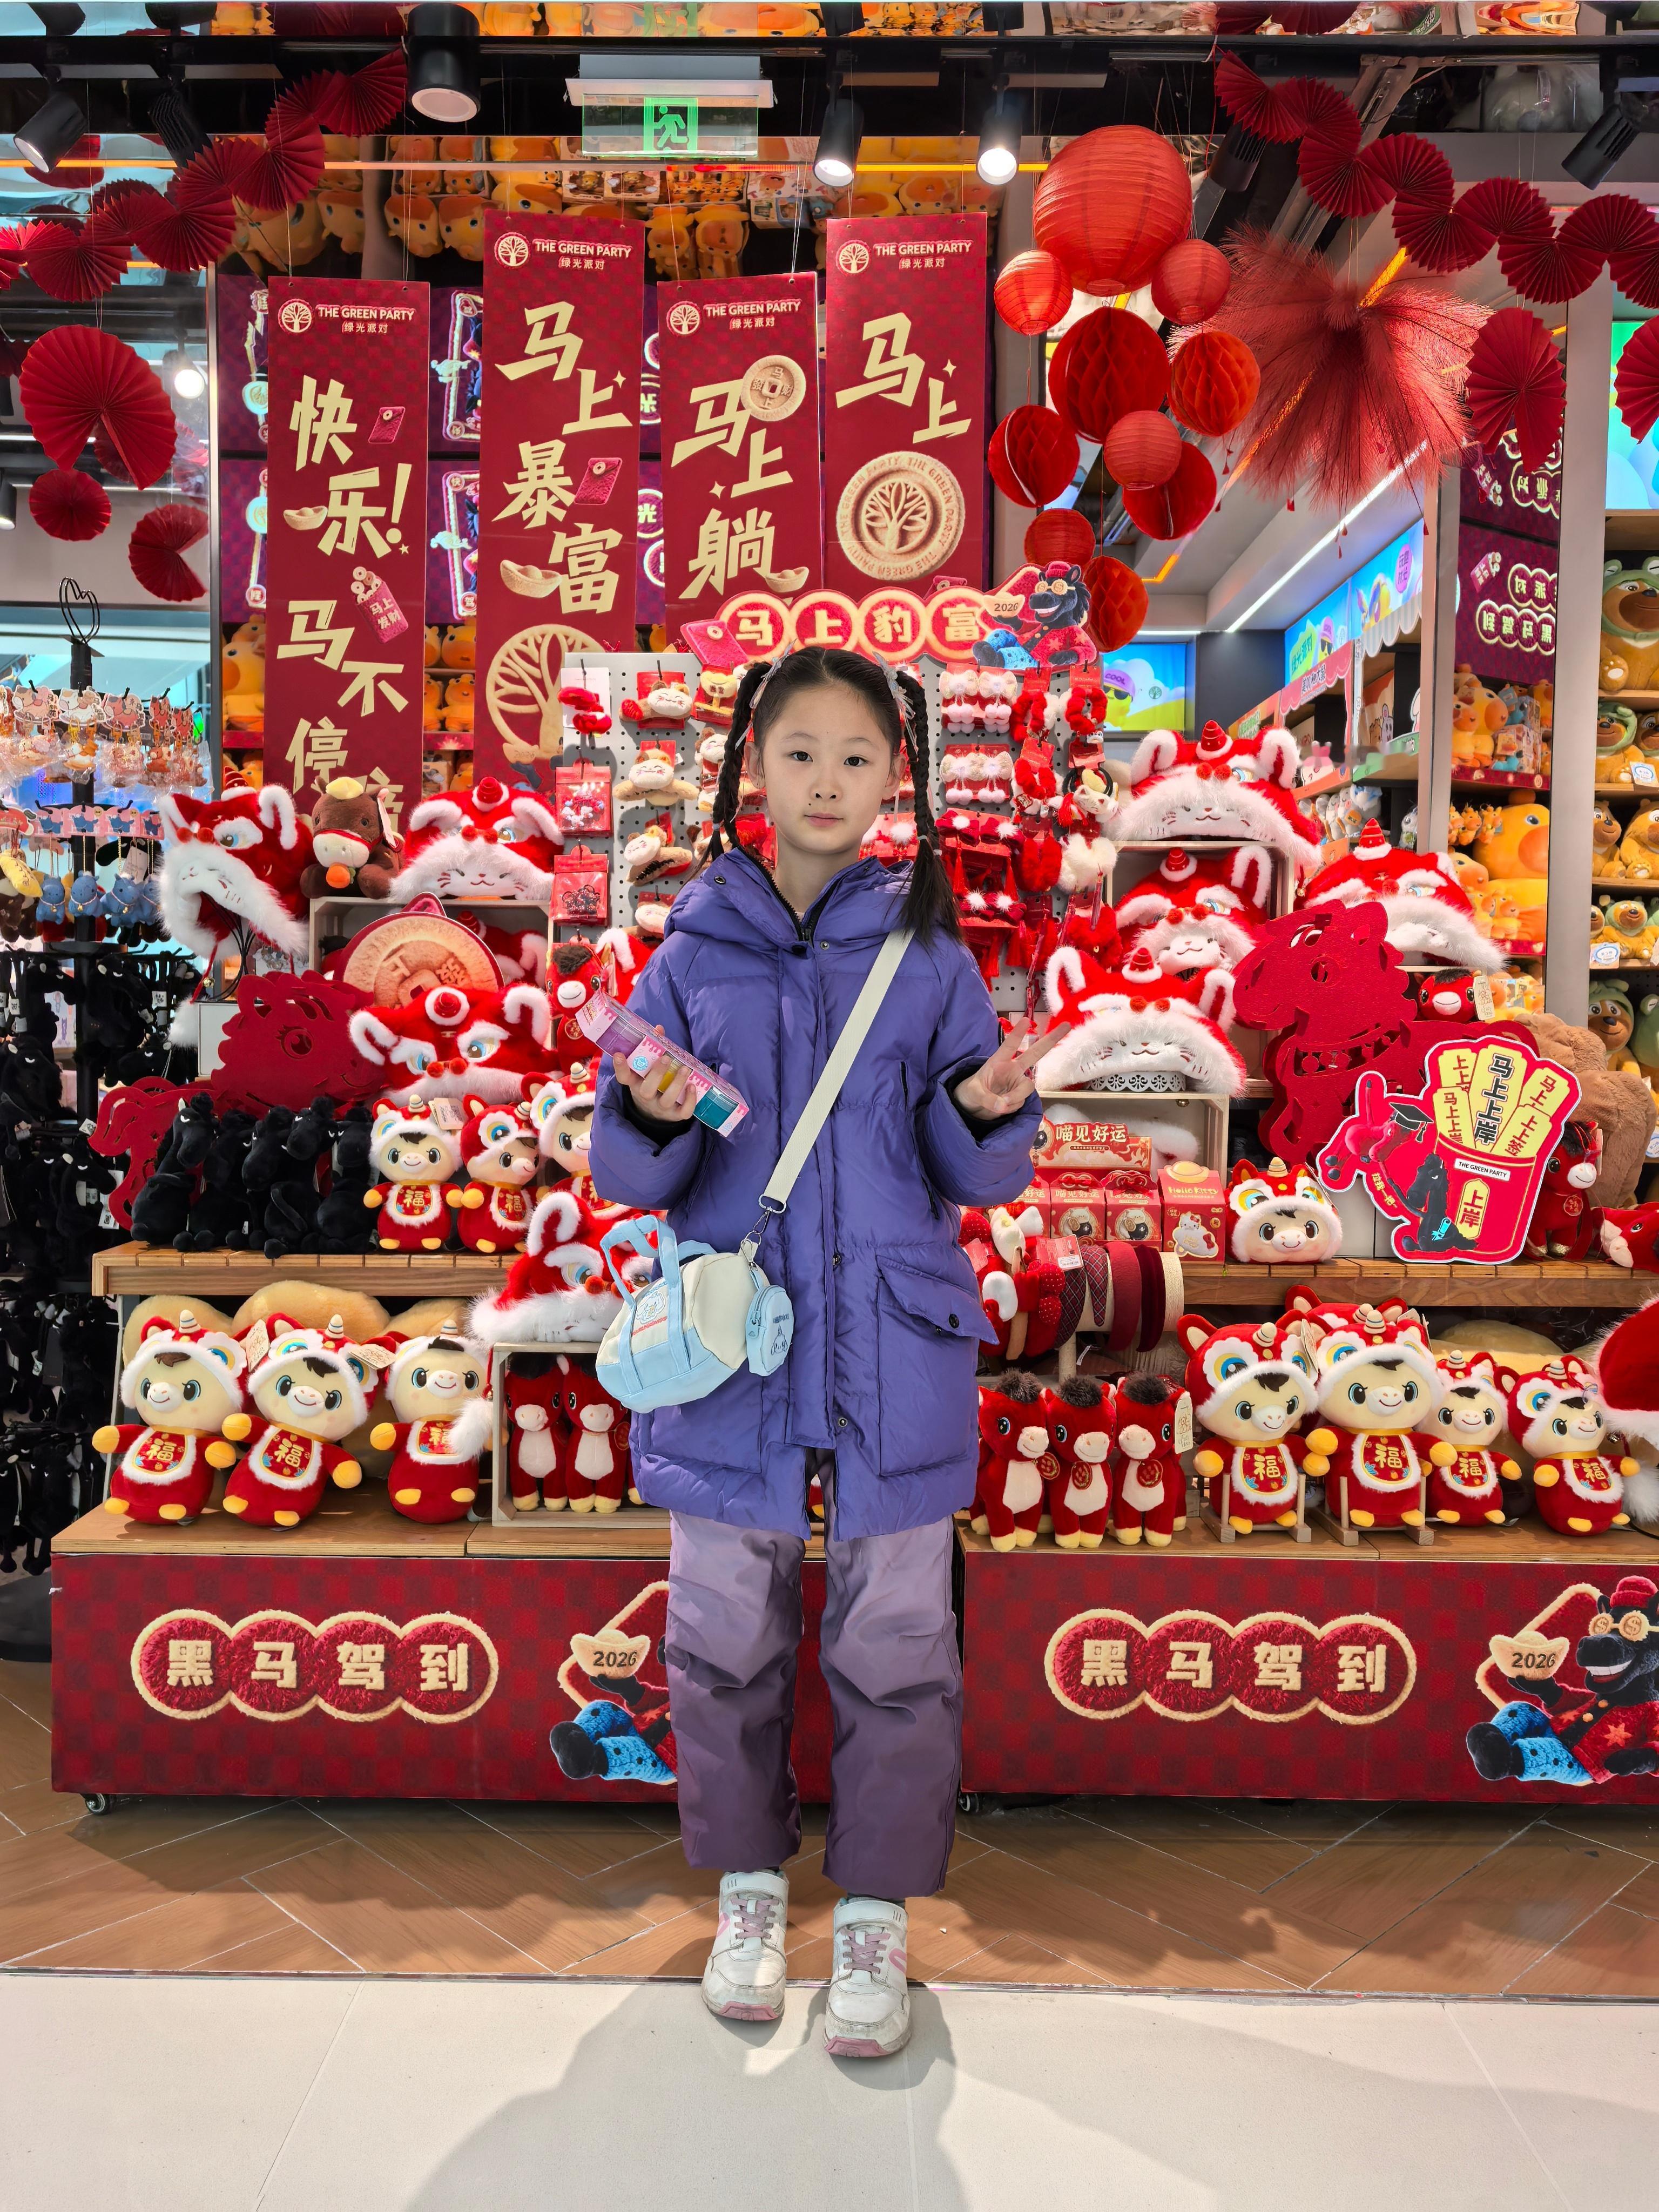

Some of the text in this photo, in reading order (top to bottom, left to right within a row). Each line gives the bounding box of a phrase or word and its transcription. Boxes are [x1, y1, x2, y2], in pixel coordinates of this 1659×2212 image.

[535, 241, 631, 258] THE GREEN PARTY
[876, 241, 972, 255] THE GREEN PARTY
[559, 258, 604, 271] 绿光派对
[901, 258, 945, 269] 绿光派对
[318, 306, 414, 321] THE GREEN PARTY
[705, 301, 800, 318] THE GREEN PARTY
[342, 322, 388, 334] 绿光派对
[731, 316, 774, 329] 绿光派对
[837, 313, 971, 443] 马上
[369, 598, 394, 615] 马上
[994, 603, 1019, 612] 2026
[377, 609, 401, 630] 发财
[736, 609, 980, 646] 马上豹富
[1105, 673, 1126, 685] COOL
[1473, 1053, 1515, 1145] 马上上岸
[1056, 1124, 1127, 1143] 喵见好运
[1504, 1115, 1538, 1157] 上上签
[1470, 1164, 1489, 1173] GREEN
[1489, 1169, 1507, 1178] PARTY
[403, 1190, 424, 1208] 福
[1055, 1189, 1101, 1199] 喵见好运
[1168, 1186, 1219, 1195] Hello Kitty
[505, 1195, 523, 1213] 福
[1459, 1189, 1485, 1228] 上岸
[146, 1439, 175, 1461] 福
[274, 1439, 305, 1467] 福
[1374, 1445, 1403, 1471] 福
[1254, 1456, 1280, 1480] 福
[1459, 1458, 1482, 1477] 福
[1583, 1462, 1607, 1482] 福
[167, 1640, 469, 1692] 黑马驾到
[593, 1651, 638, 1668] 2026
[1081, 1640, 1387, 1694] 黑马驾到
[1512, 1652, 1556, 1669] 2026
